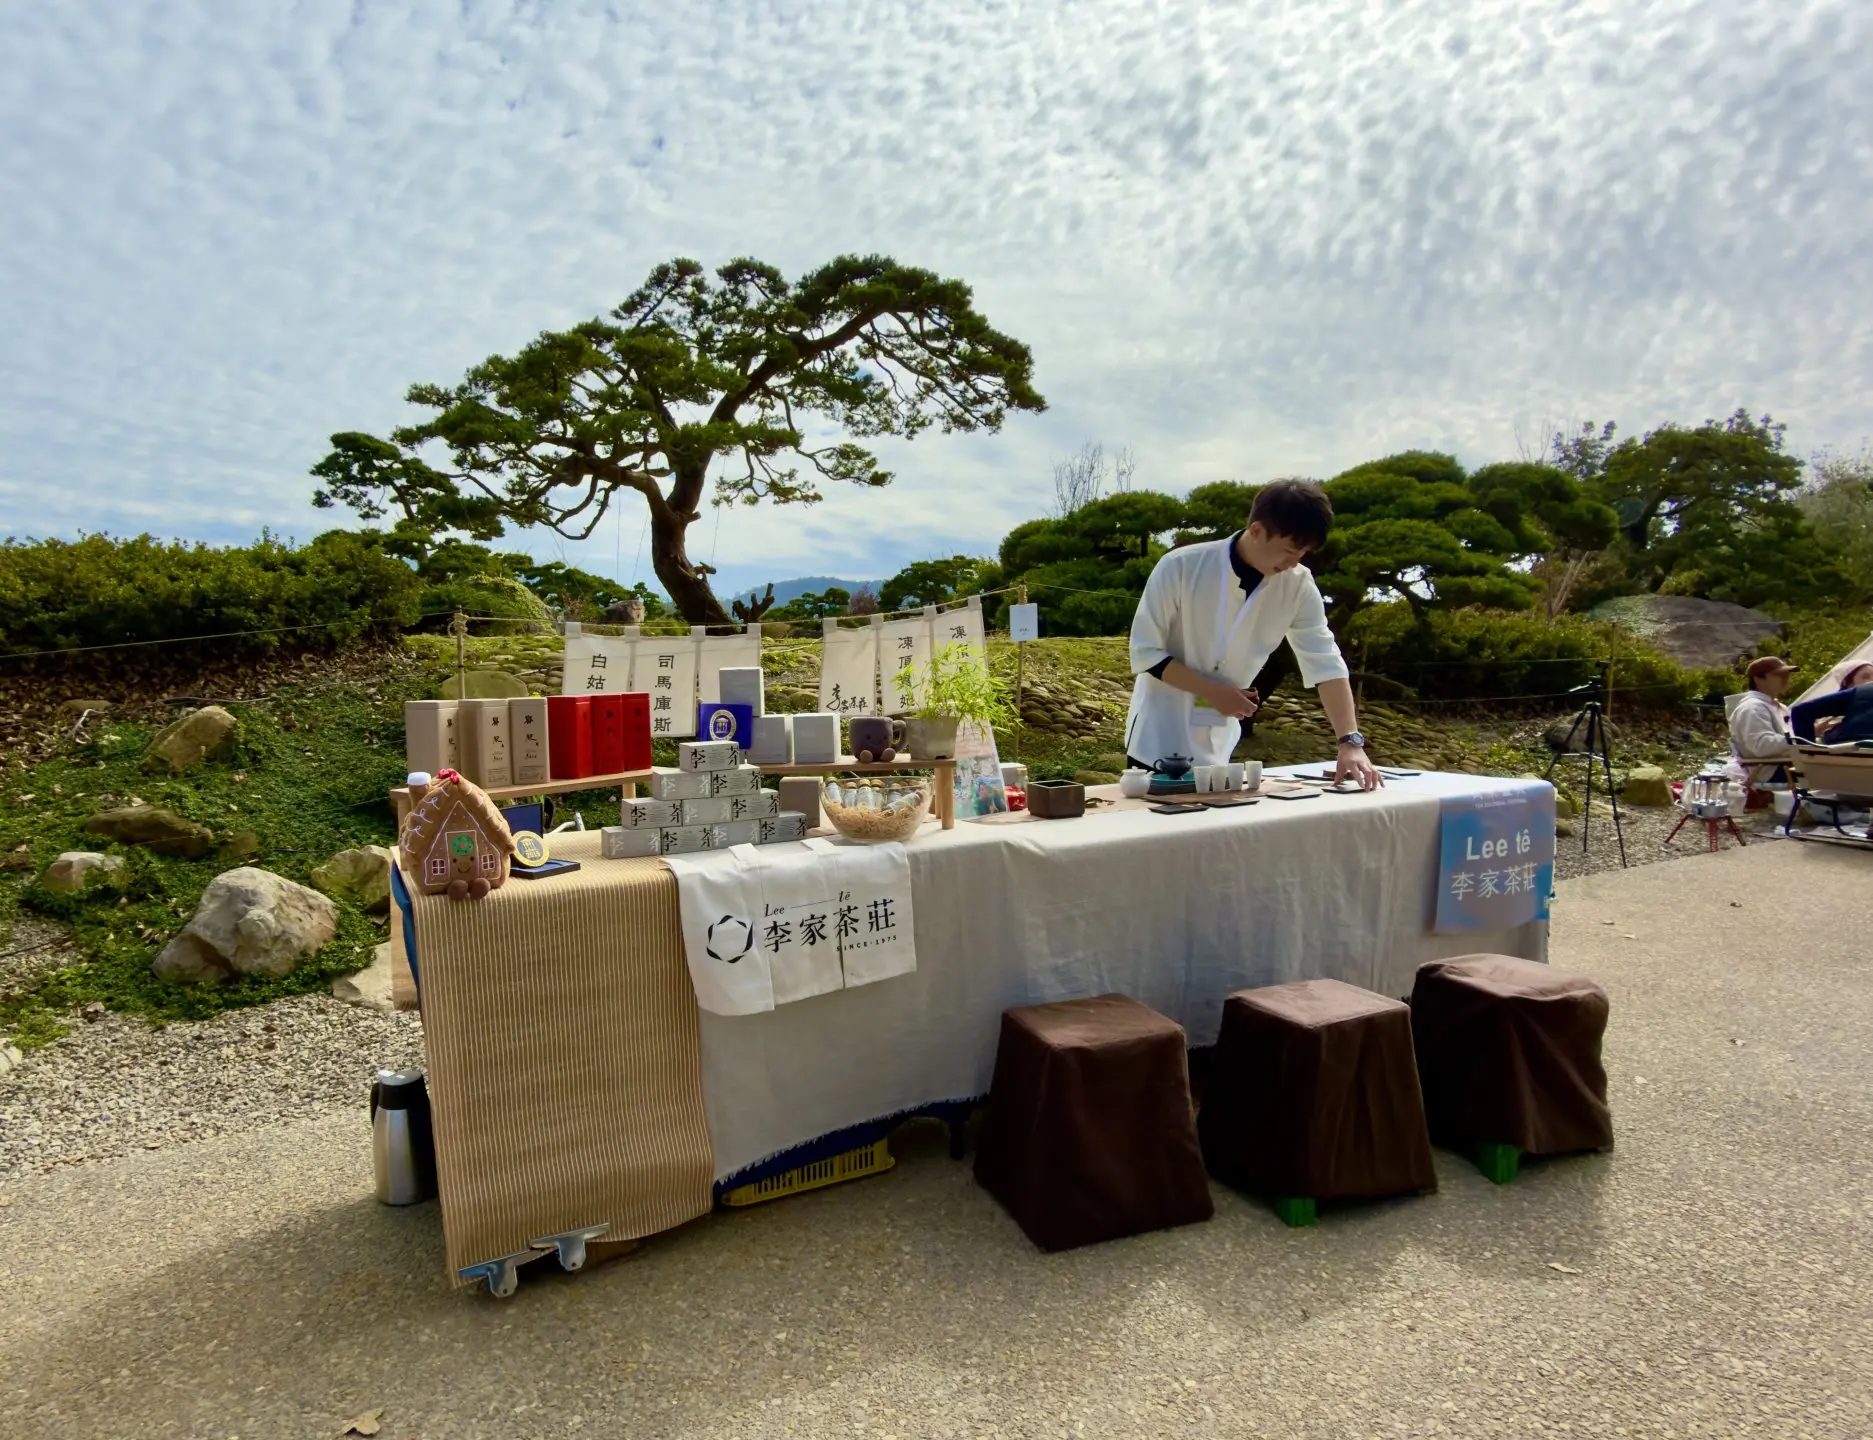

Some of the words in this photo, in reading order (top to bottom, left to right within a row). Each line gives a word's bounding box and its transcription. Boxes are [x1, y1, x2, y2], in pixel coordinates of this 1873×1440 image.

[587, 654, 607, 690] 白姑
[653, 655, 675, 732] 司馬庫斯
[1466, 836, 1508, 861] Lee
[1451, 862, 1538, 901] 李家茶莊
[763, 898, 897, 954] 李家茶莊
[764, 903, 786, 918] Lee
